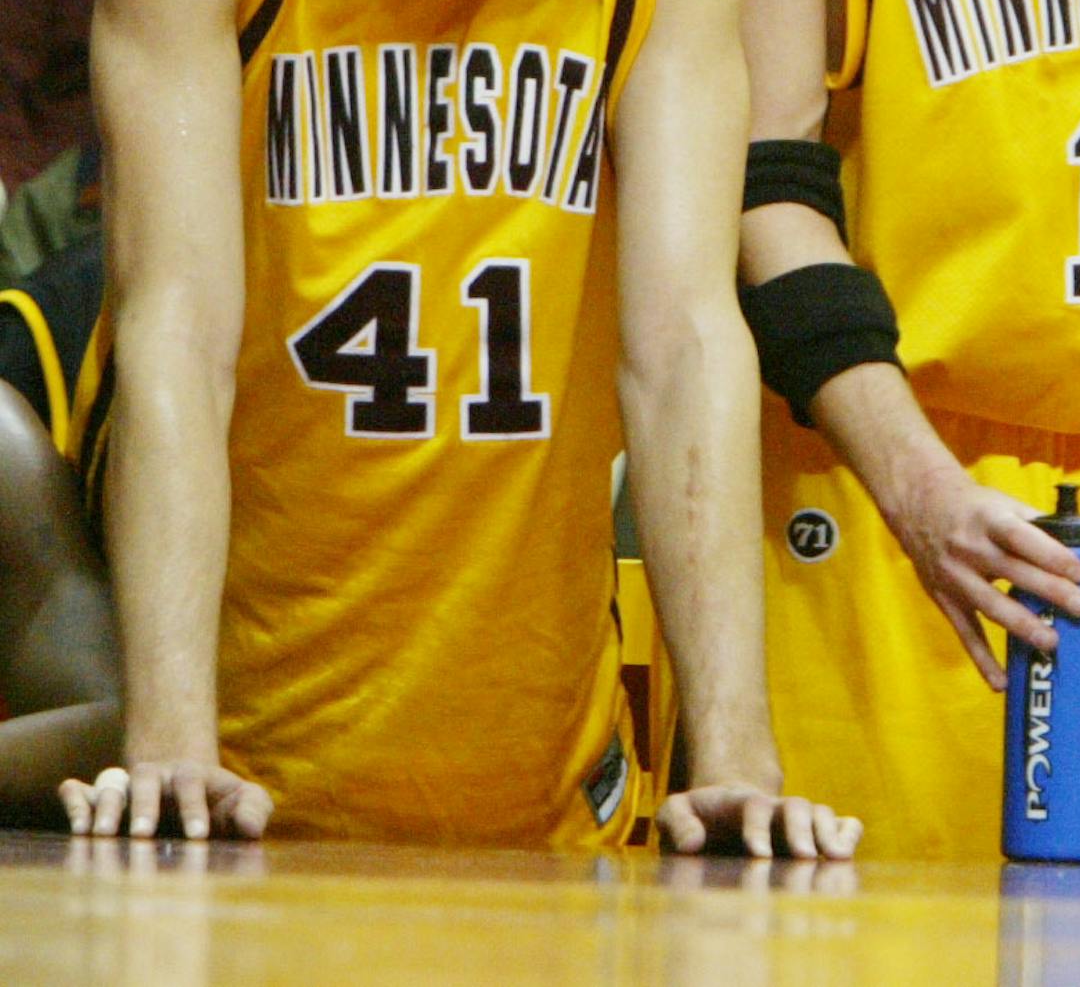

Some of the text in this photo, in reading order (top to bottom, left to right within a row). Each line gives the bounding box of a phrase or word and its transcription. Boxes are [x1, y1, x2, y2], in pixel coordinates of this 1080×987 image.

[266, 43, 606, 214] MINNESOTA
[286, 257, 551, 441] 41
[794, 522, 829, 548] 71
[1026, 648, 1054, 820] POWER
